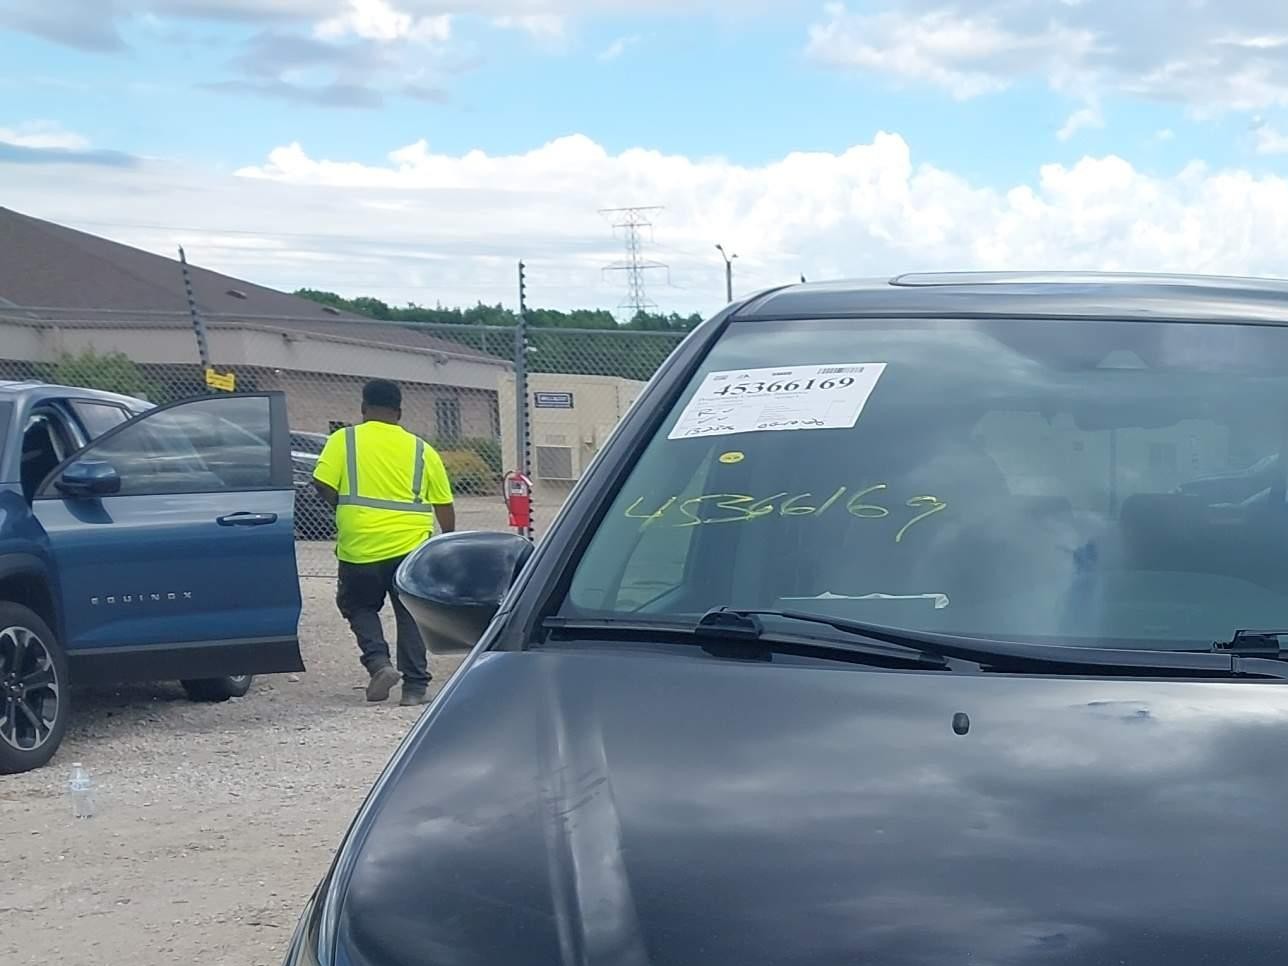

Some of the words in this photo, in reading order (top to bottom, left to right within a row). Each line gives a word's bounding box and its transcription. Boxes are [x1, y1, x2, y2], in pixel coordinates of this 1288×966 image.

[713, 376, 855, 396] 45366169
[624, 484, 946, 542] 45366169
[90, 591, 192, 604] EQUINOX
